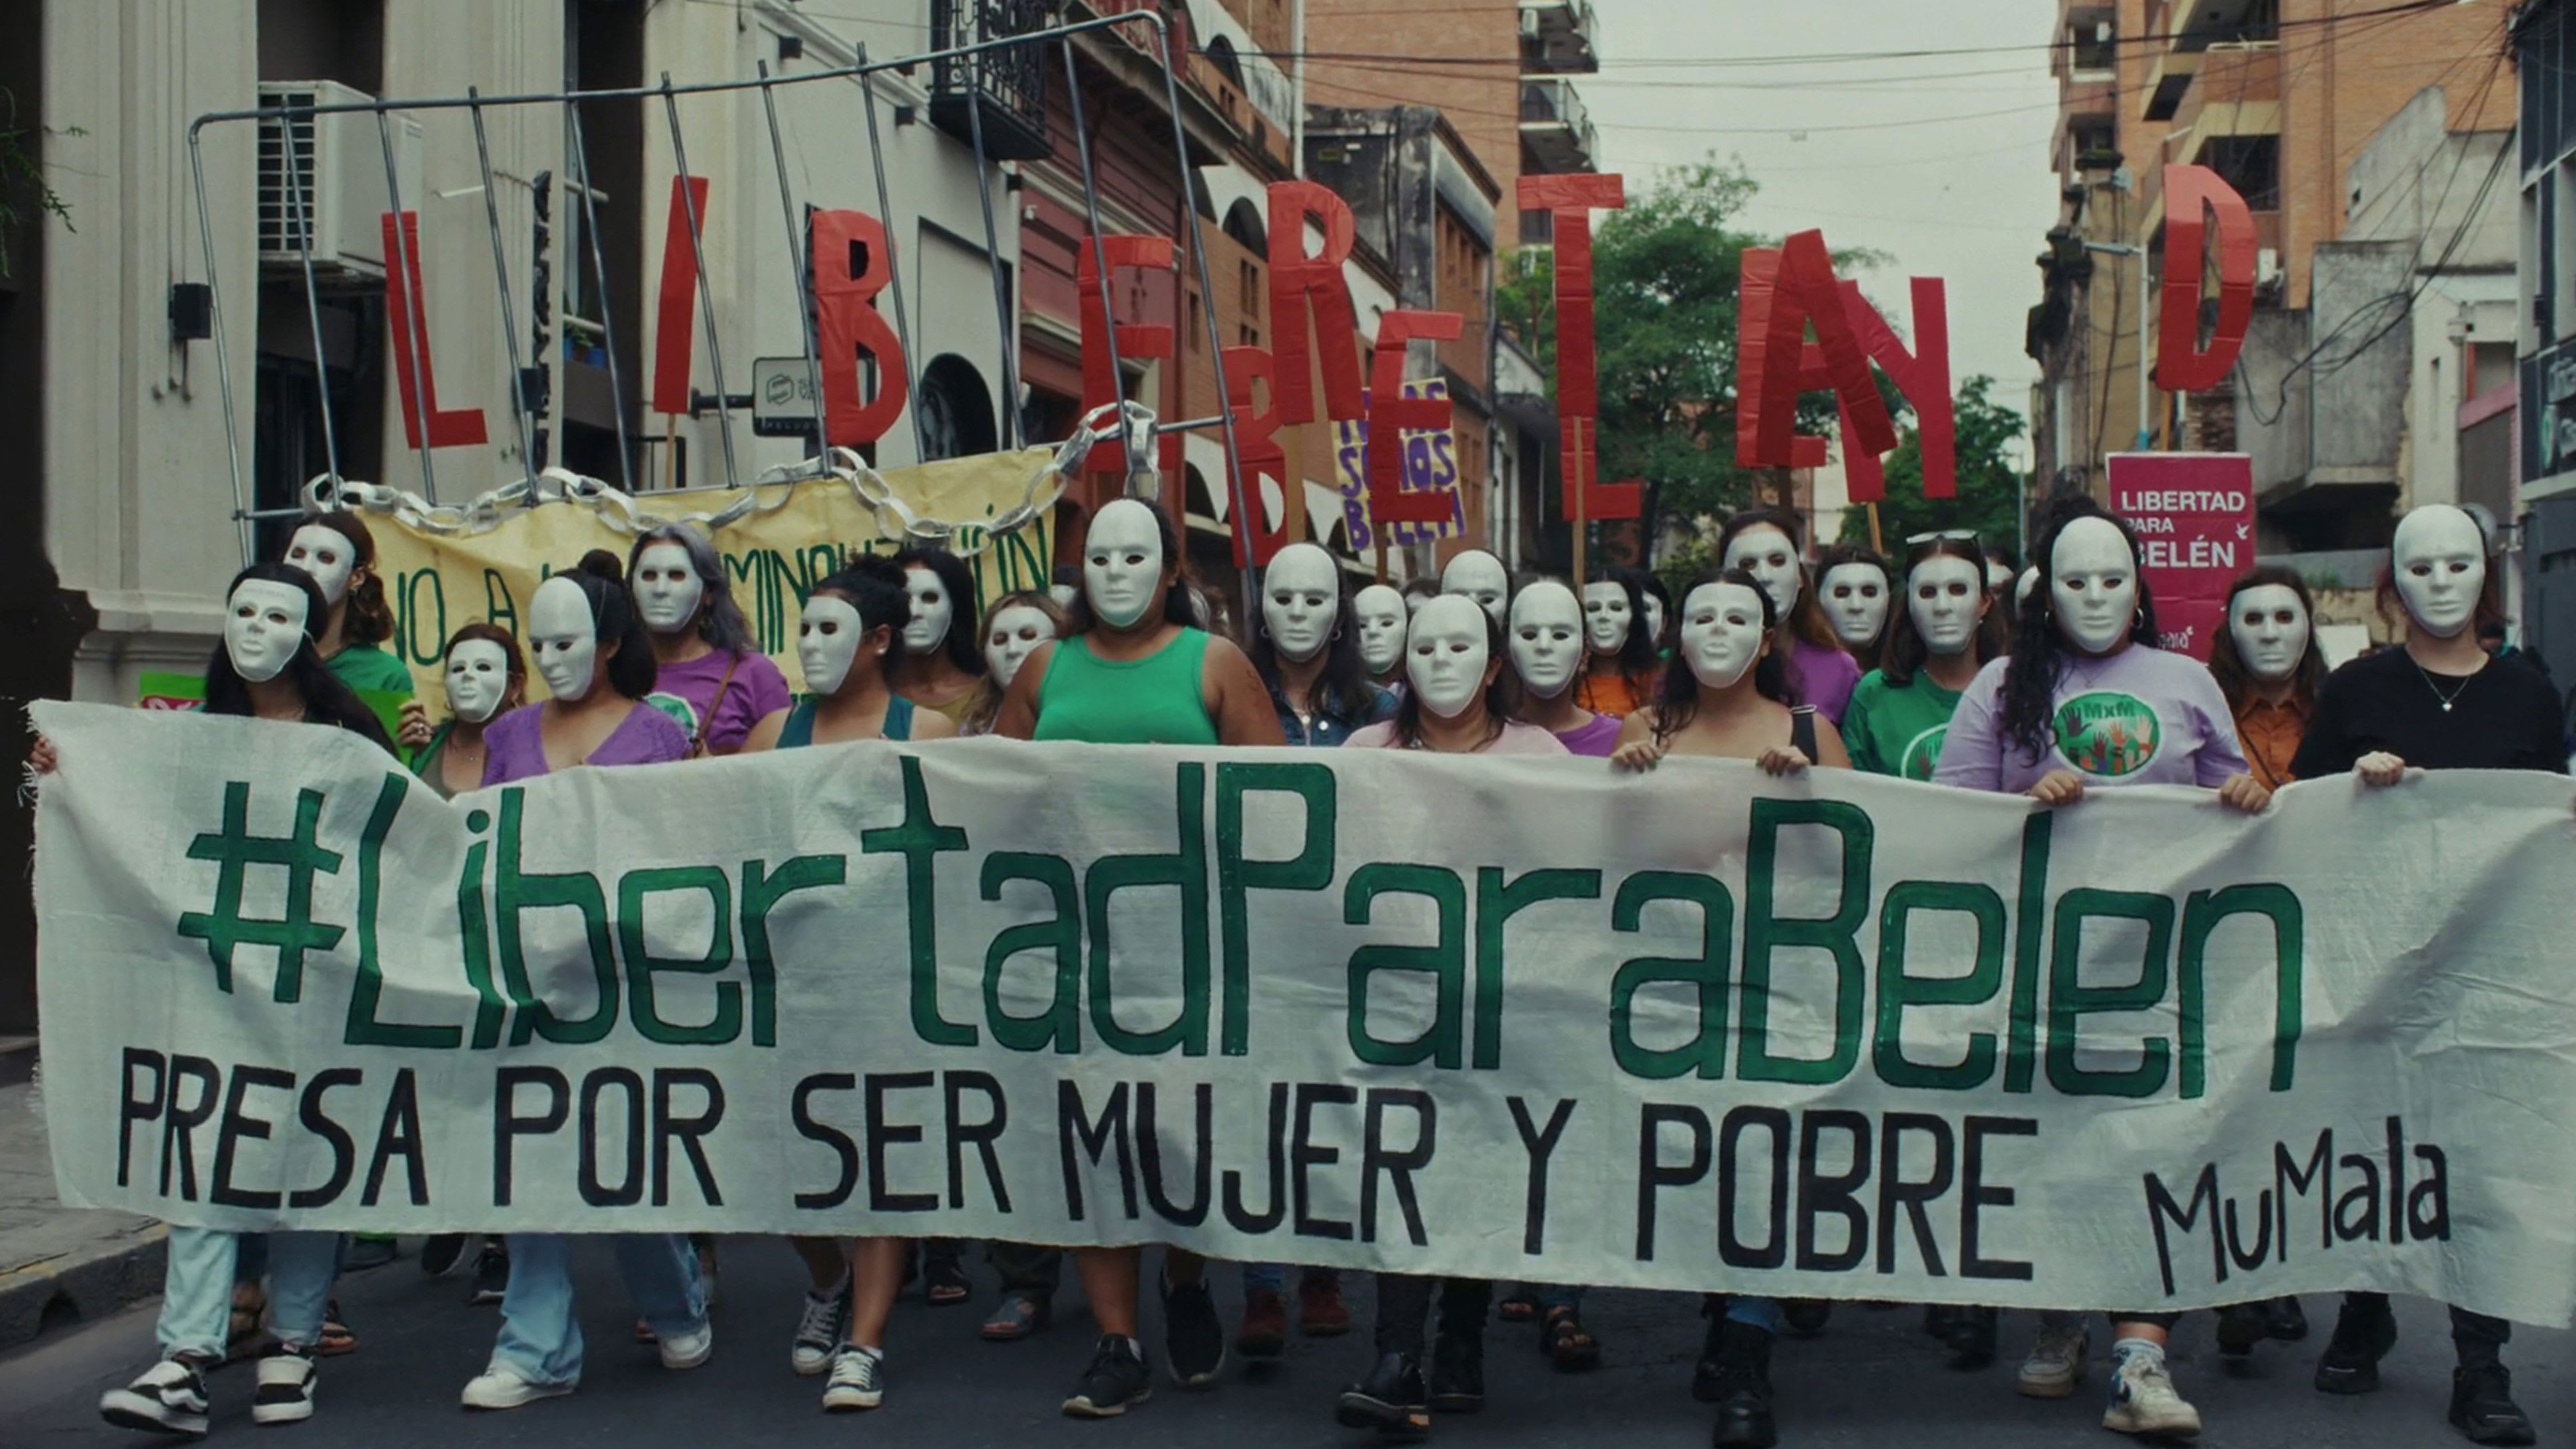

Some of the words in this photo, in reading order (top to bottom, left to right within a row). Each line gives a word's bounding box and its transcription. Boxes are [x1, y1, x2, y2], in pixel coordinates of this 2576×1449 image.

[1339, 433, 1456, 498] SOS
[2121, 491, 2245, 511] LIBERTAD
[2083, 701, 2136, 718] MxM
[177, 756, 2303, 1099] #LibertadParaBelen
[118, 1047, 429, 1210] PRESA
[494, 1065, 725, 1208] POR
[791, 1070, 1013, 1214] SER
[1058, 1079, 1436, 1246] MUJER
[1506, 1095, 1577, 1255] Y
[1636, 1102, 2038, 1281] POBRE
[2143, 1115, 2451, 1297] MuMala
